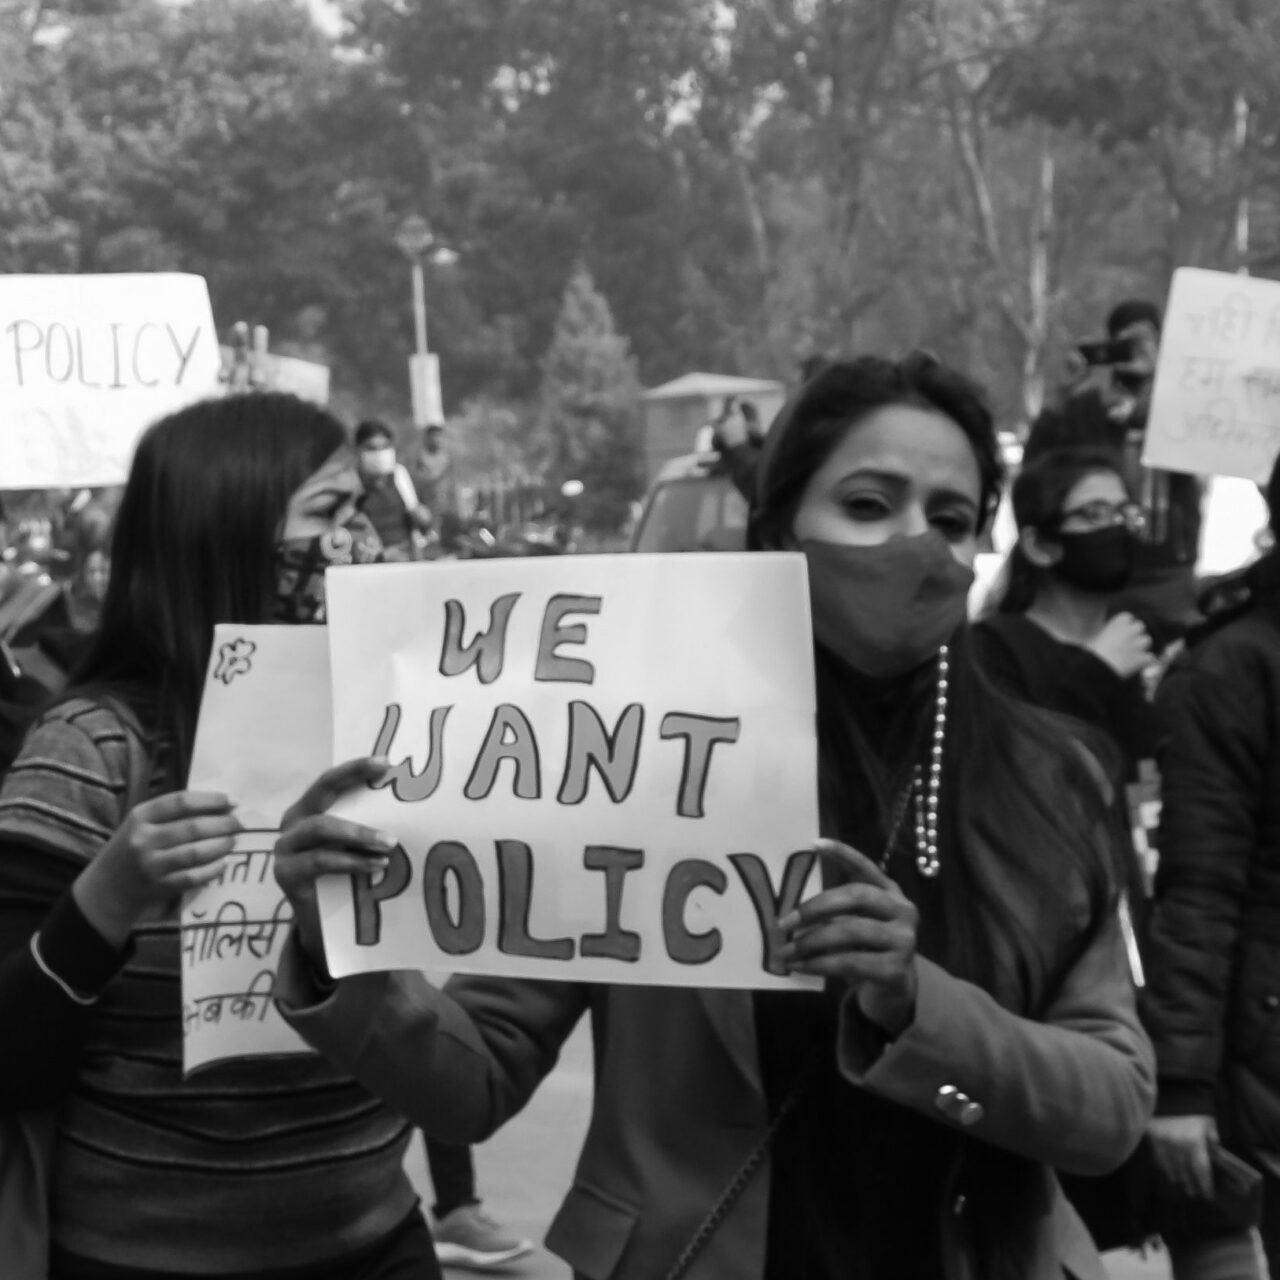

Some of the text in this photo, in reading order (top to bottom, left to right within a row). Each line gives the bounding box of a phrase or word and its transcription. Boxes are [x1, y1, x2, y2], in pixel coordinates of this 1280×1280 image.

[5, 319, 202, 390] POLICY
[439, 591, 603, 685] WE
[365, 700, 740, 819] WANT
[350, 838, 818, 976] POLICY
